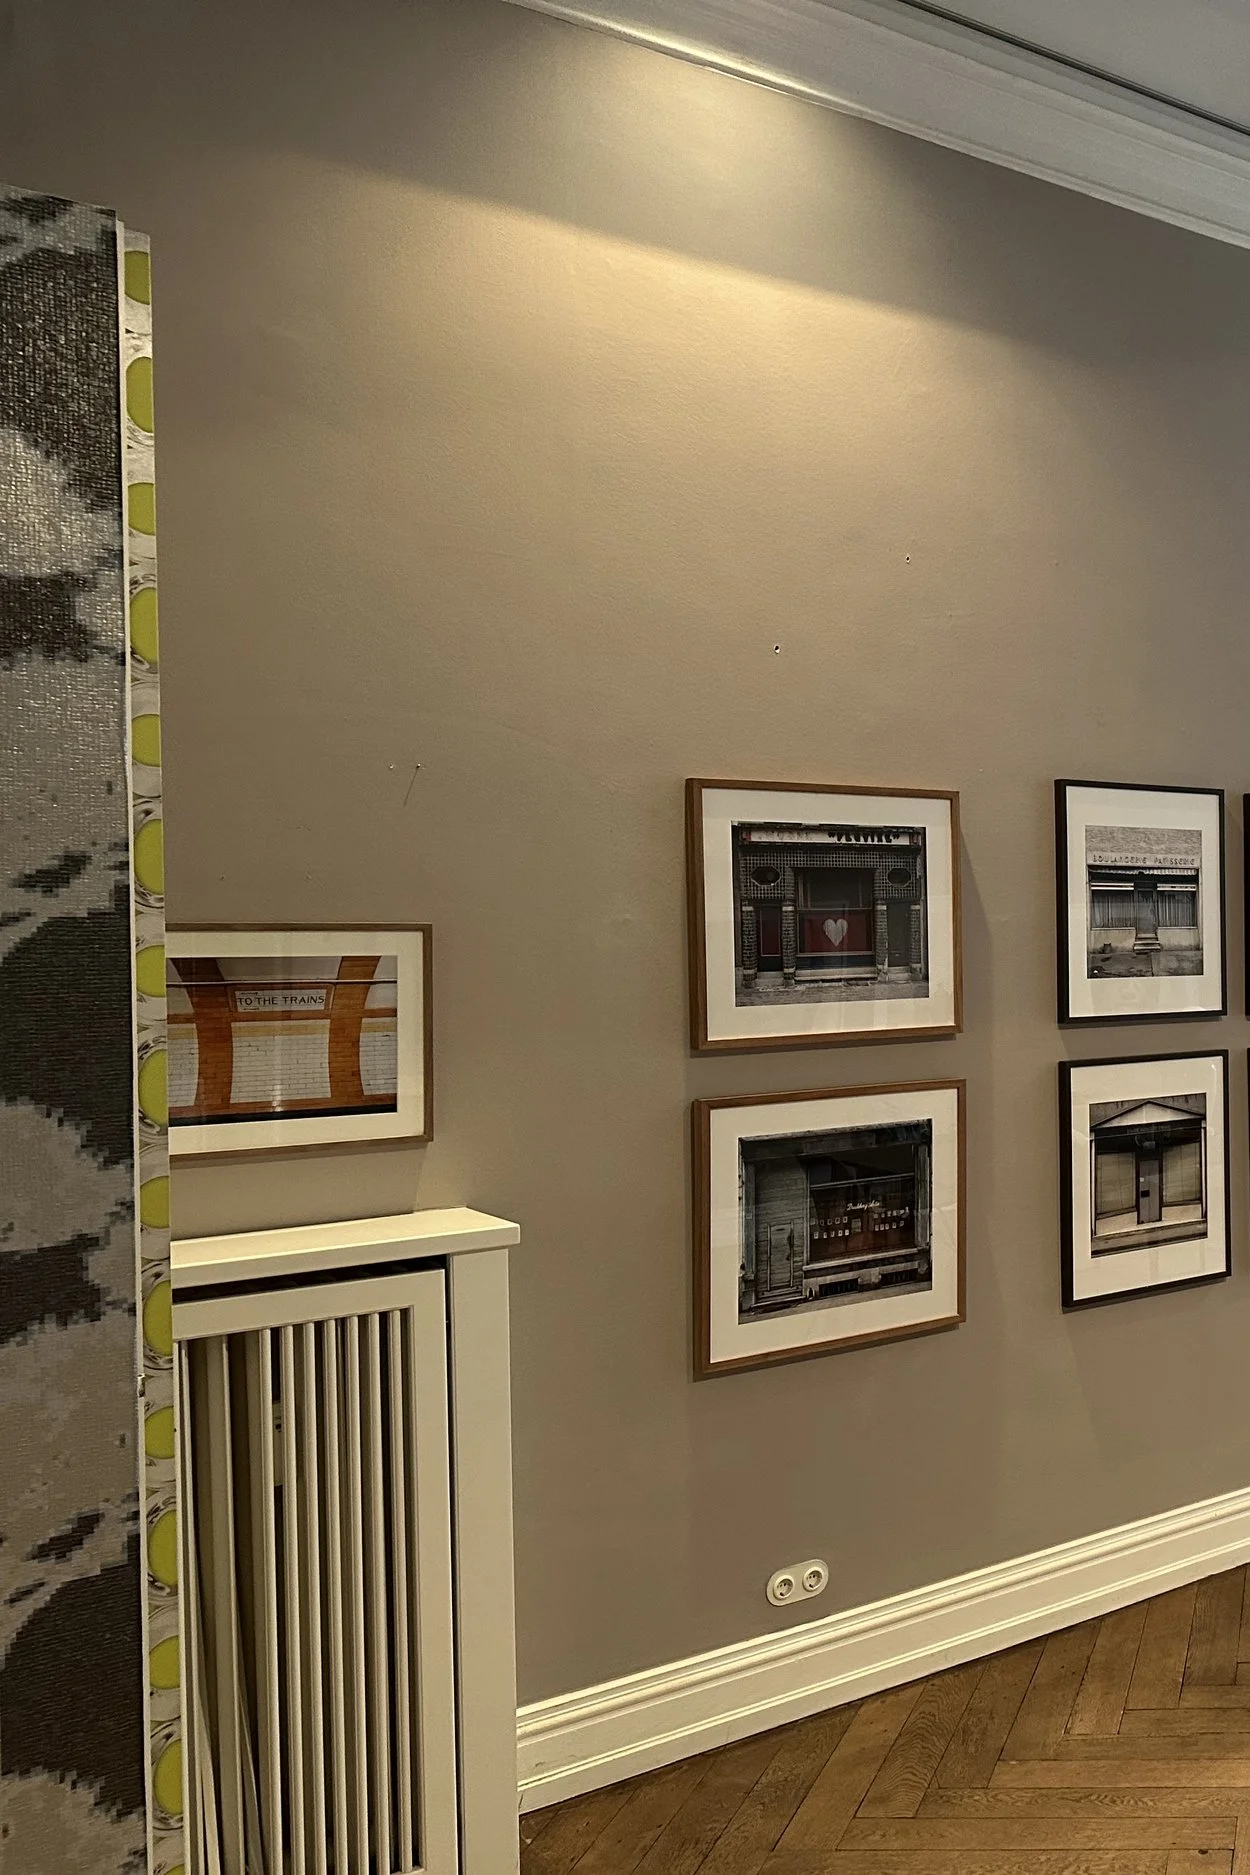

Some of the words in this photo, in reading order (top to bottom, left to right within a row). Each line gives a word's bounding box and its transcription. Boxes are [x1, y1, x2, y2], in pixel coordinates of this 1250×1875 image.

[238, 997, 253, 1005] TO
[256, 996, 278, 1005] THE
[282, 995, 324, 1005] TRAINS
